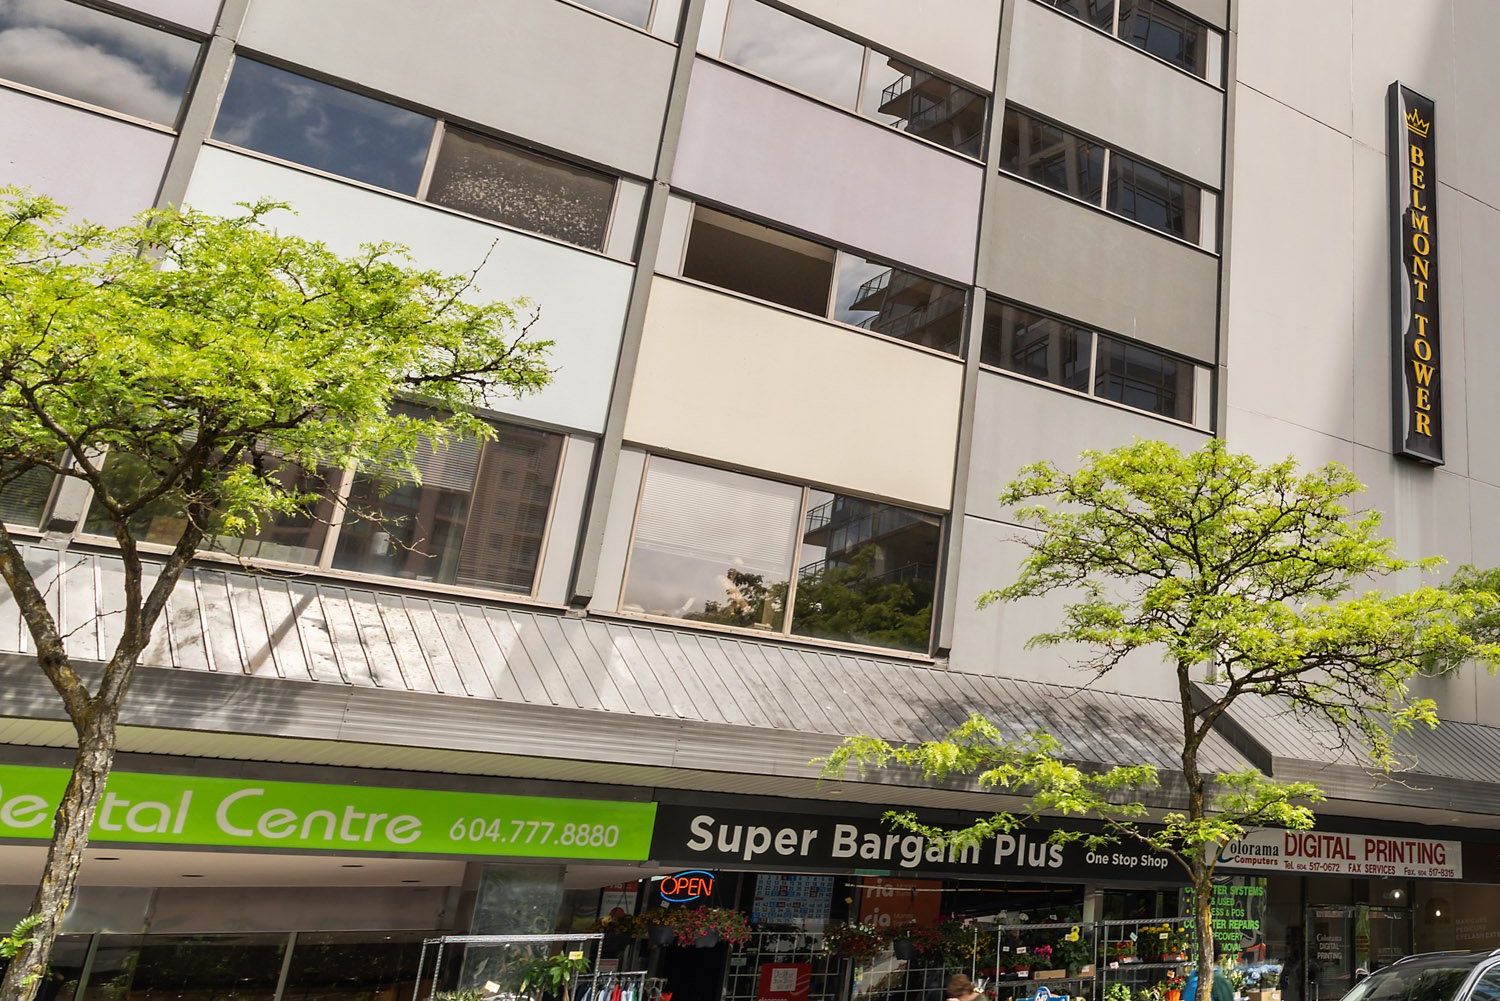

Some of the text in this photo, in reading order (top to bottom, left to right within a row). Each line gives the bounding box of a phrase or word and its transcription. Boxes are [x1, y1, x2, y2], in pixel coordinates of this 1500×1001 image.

[1409, 143, 1435, 437] BELMONT TOWER
[0, 785, 619, 847] etal Centre 604.777.8880
[686, 815, 818, 861] Super
[994, 834, 1063, 868] Plus
[1284, 832, 1447, 866] DIGITAL PRINTING
[1085, 851, 1169, 869] One Stop Shop
[1234, 855, 1279, 866] Computers
[1309, 862, 1341, 872] 517-0672
[1348, 863, 1362, 873] FAX
[1364, 864, 1396, 875] SERVICES
[1428, 867, 1455, 878] 517-8315
[660, 876, 713, 897] OPEN
[1230, 886, 1264, 896] SYSTEMS
[1217, 897, 1236, 906] USED
[1231, 908, 1245, 917] POS
[1229, 919, 1260, 930] REPAIRS
[1455, 932, 1485, 941] EYELASH
[1319, 942, 1340, 950] DIGITAL
[1316, 951, 1343, 960] PRINTING
